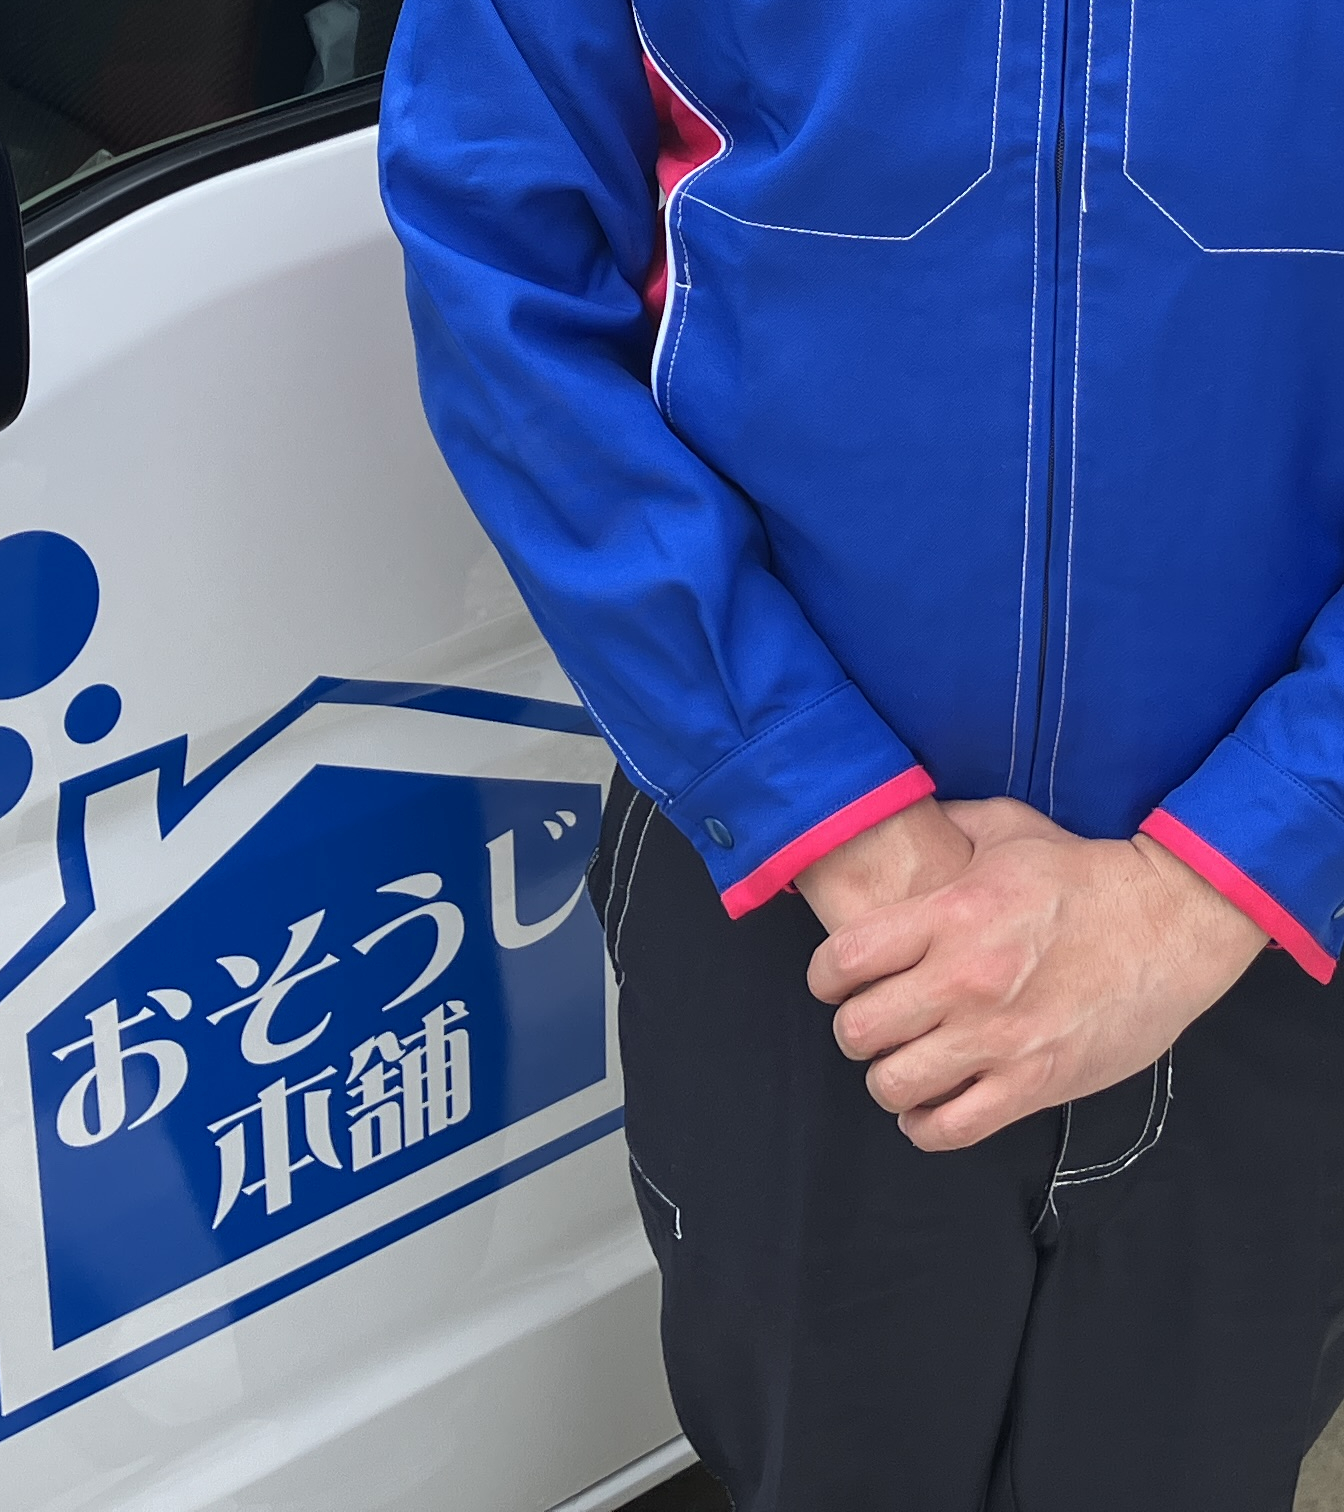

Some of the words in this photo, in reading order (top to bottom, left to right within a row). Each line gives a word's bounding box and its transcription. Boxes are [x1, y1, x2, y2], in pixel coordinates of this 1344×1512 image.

[52, 809, 586, 1149] おそうじ
[206, 999, 472, 1231] 本舗
